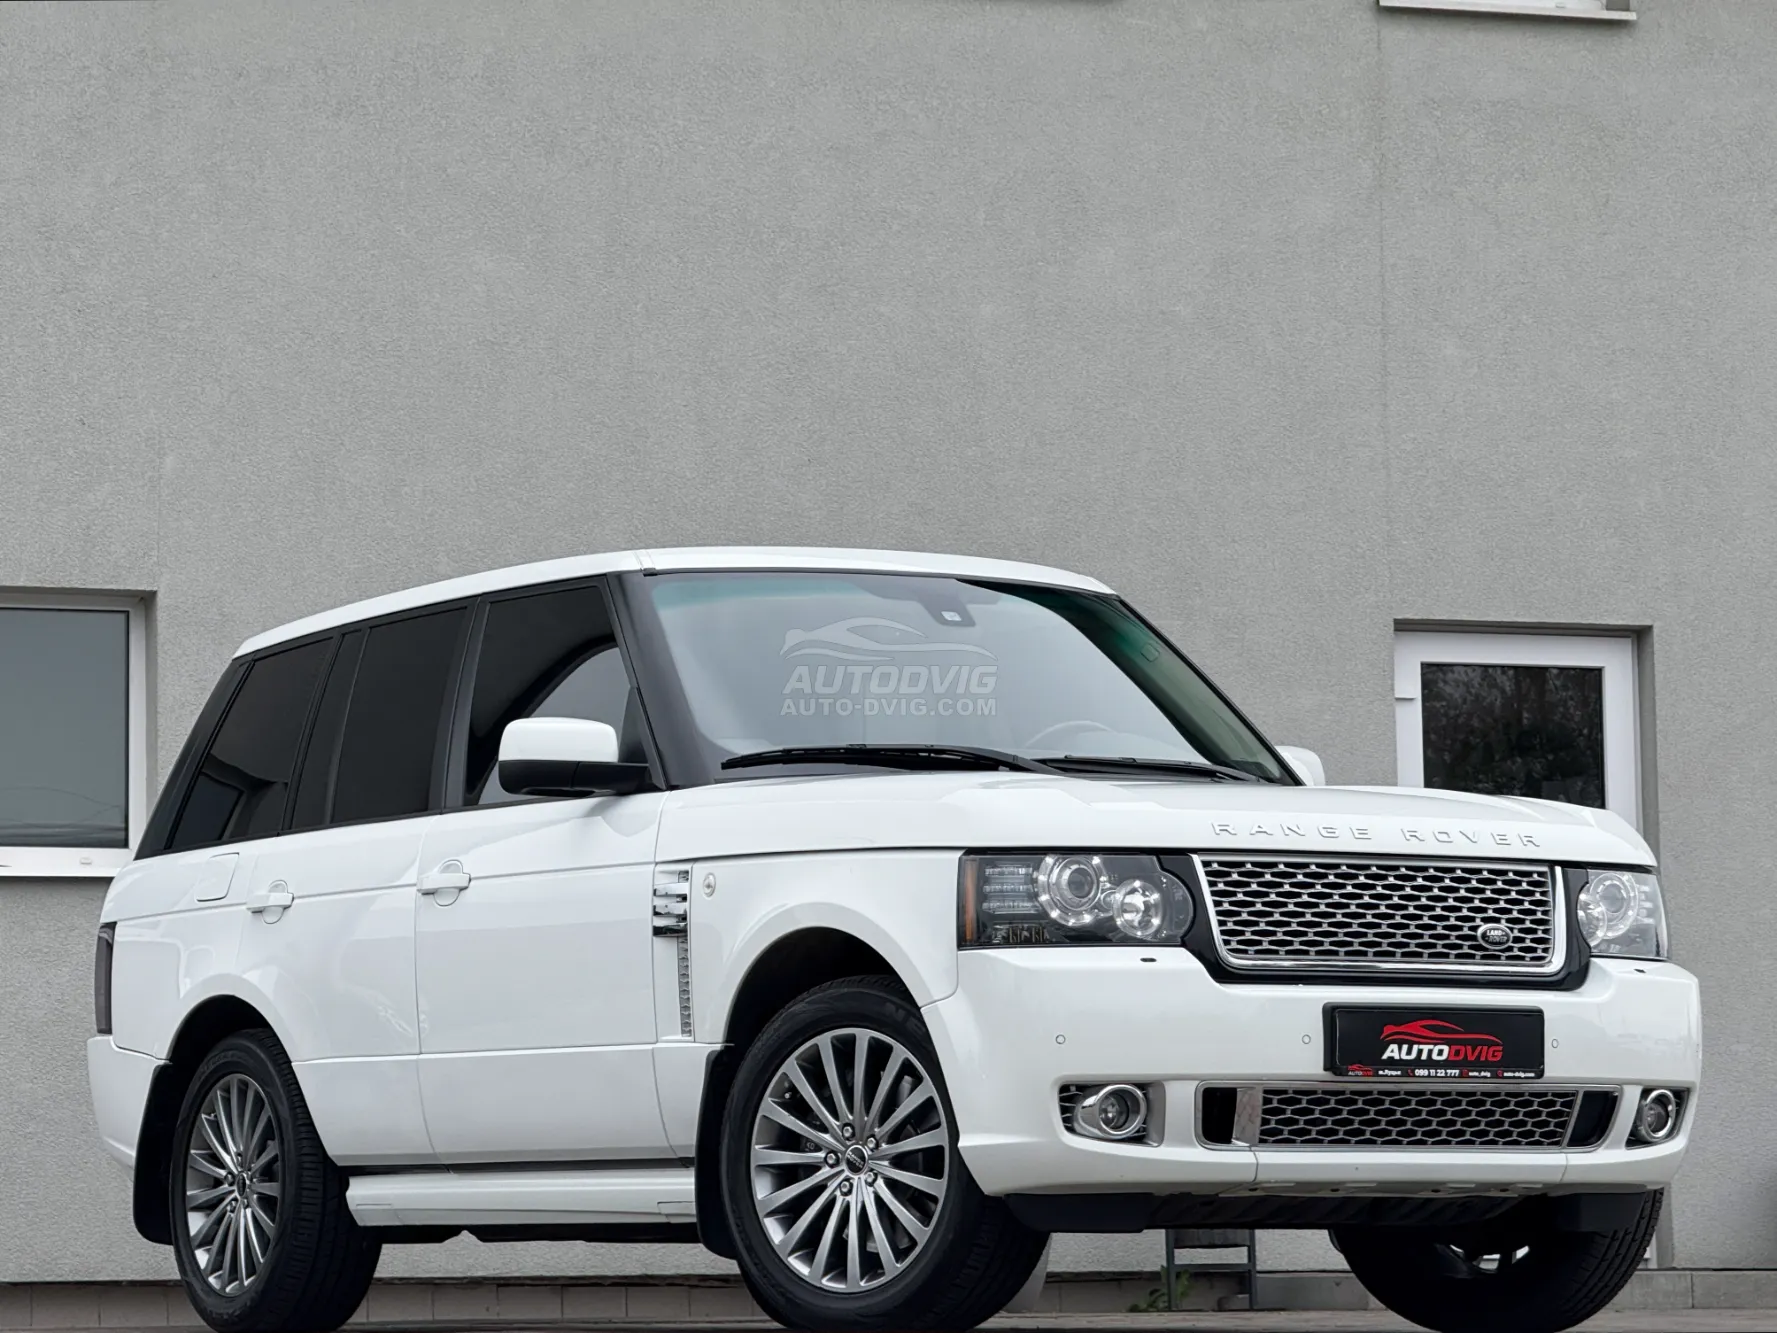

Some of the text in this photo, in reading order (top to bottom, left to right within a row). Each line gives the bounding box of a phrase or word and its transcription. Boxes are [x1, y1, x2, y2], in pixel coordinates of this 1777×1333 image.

[1211, 822, 1540, 848] RANGE ROVER
[1381, 1043, 1504, 1061] AUTODVIG
[1414, 1068, 1460, 1077] 099 11 22 777
